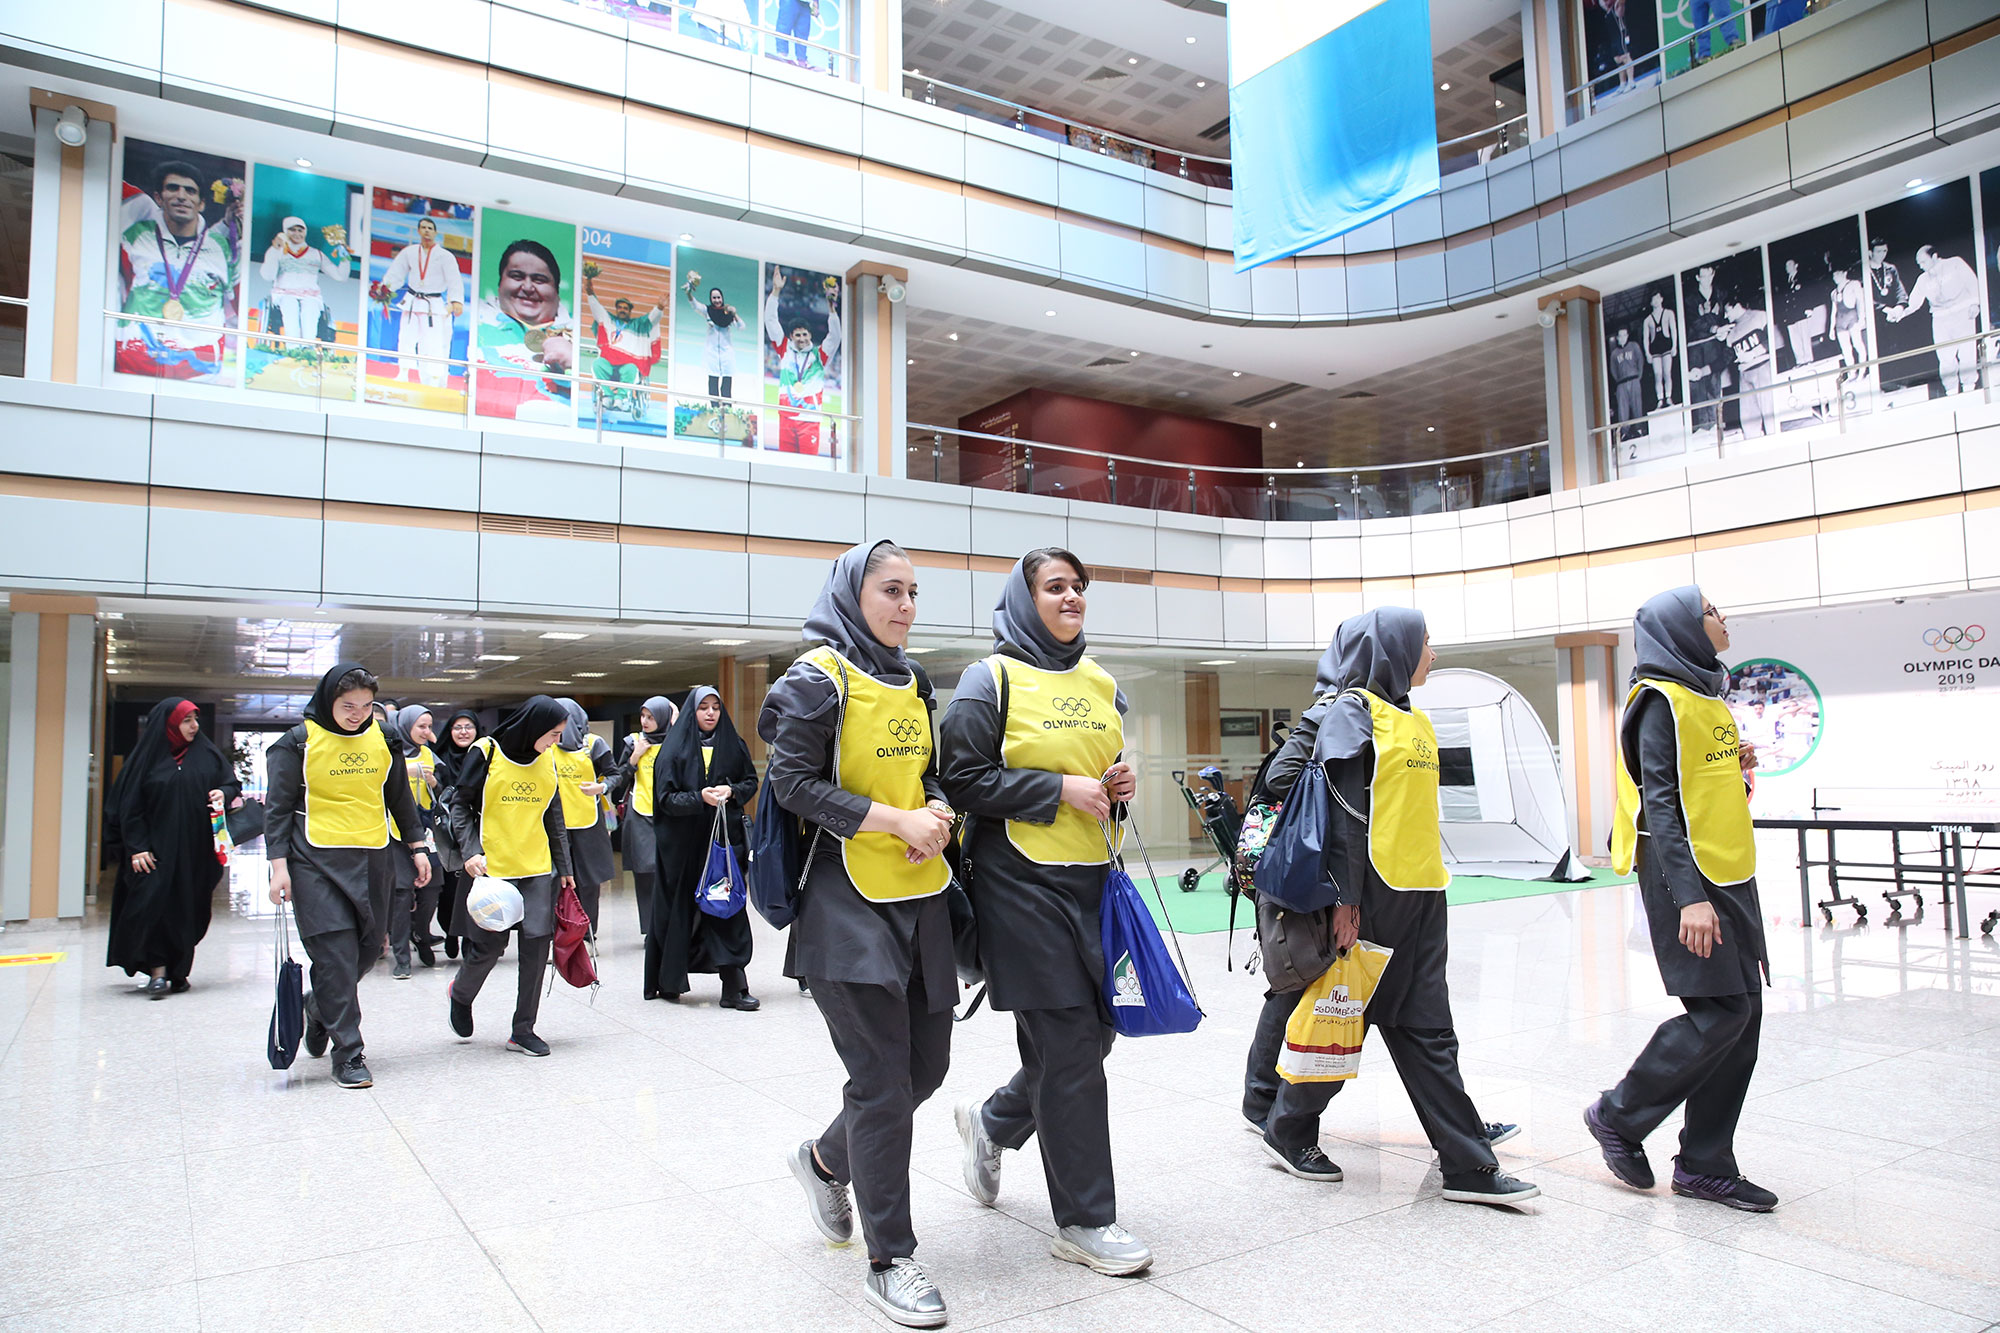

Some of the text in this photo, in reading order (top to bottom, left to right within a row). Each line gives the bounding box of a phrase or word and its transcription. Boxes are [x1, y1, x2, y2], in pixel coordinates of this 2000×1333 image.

[1845, 390, 1857, 411] 3
[1629, 443, 1638, 460] 2
[1904, 657, 2000, 673] OLYMPIC DA
[1938, 673, 1975, 685] 2019
[1043, 720, 1107, 732] OLYMPIC DAY
[876, 746, 920, 758] OLYMPIC
[1705, 747, 1738, 762] OLYMP
[329, 768, 364, 776] OLYMPIC
[1931, 825, 1973, 833] TIBHAR
